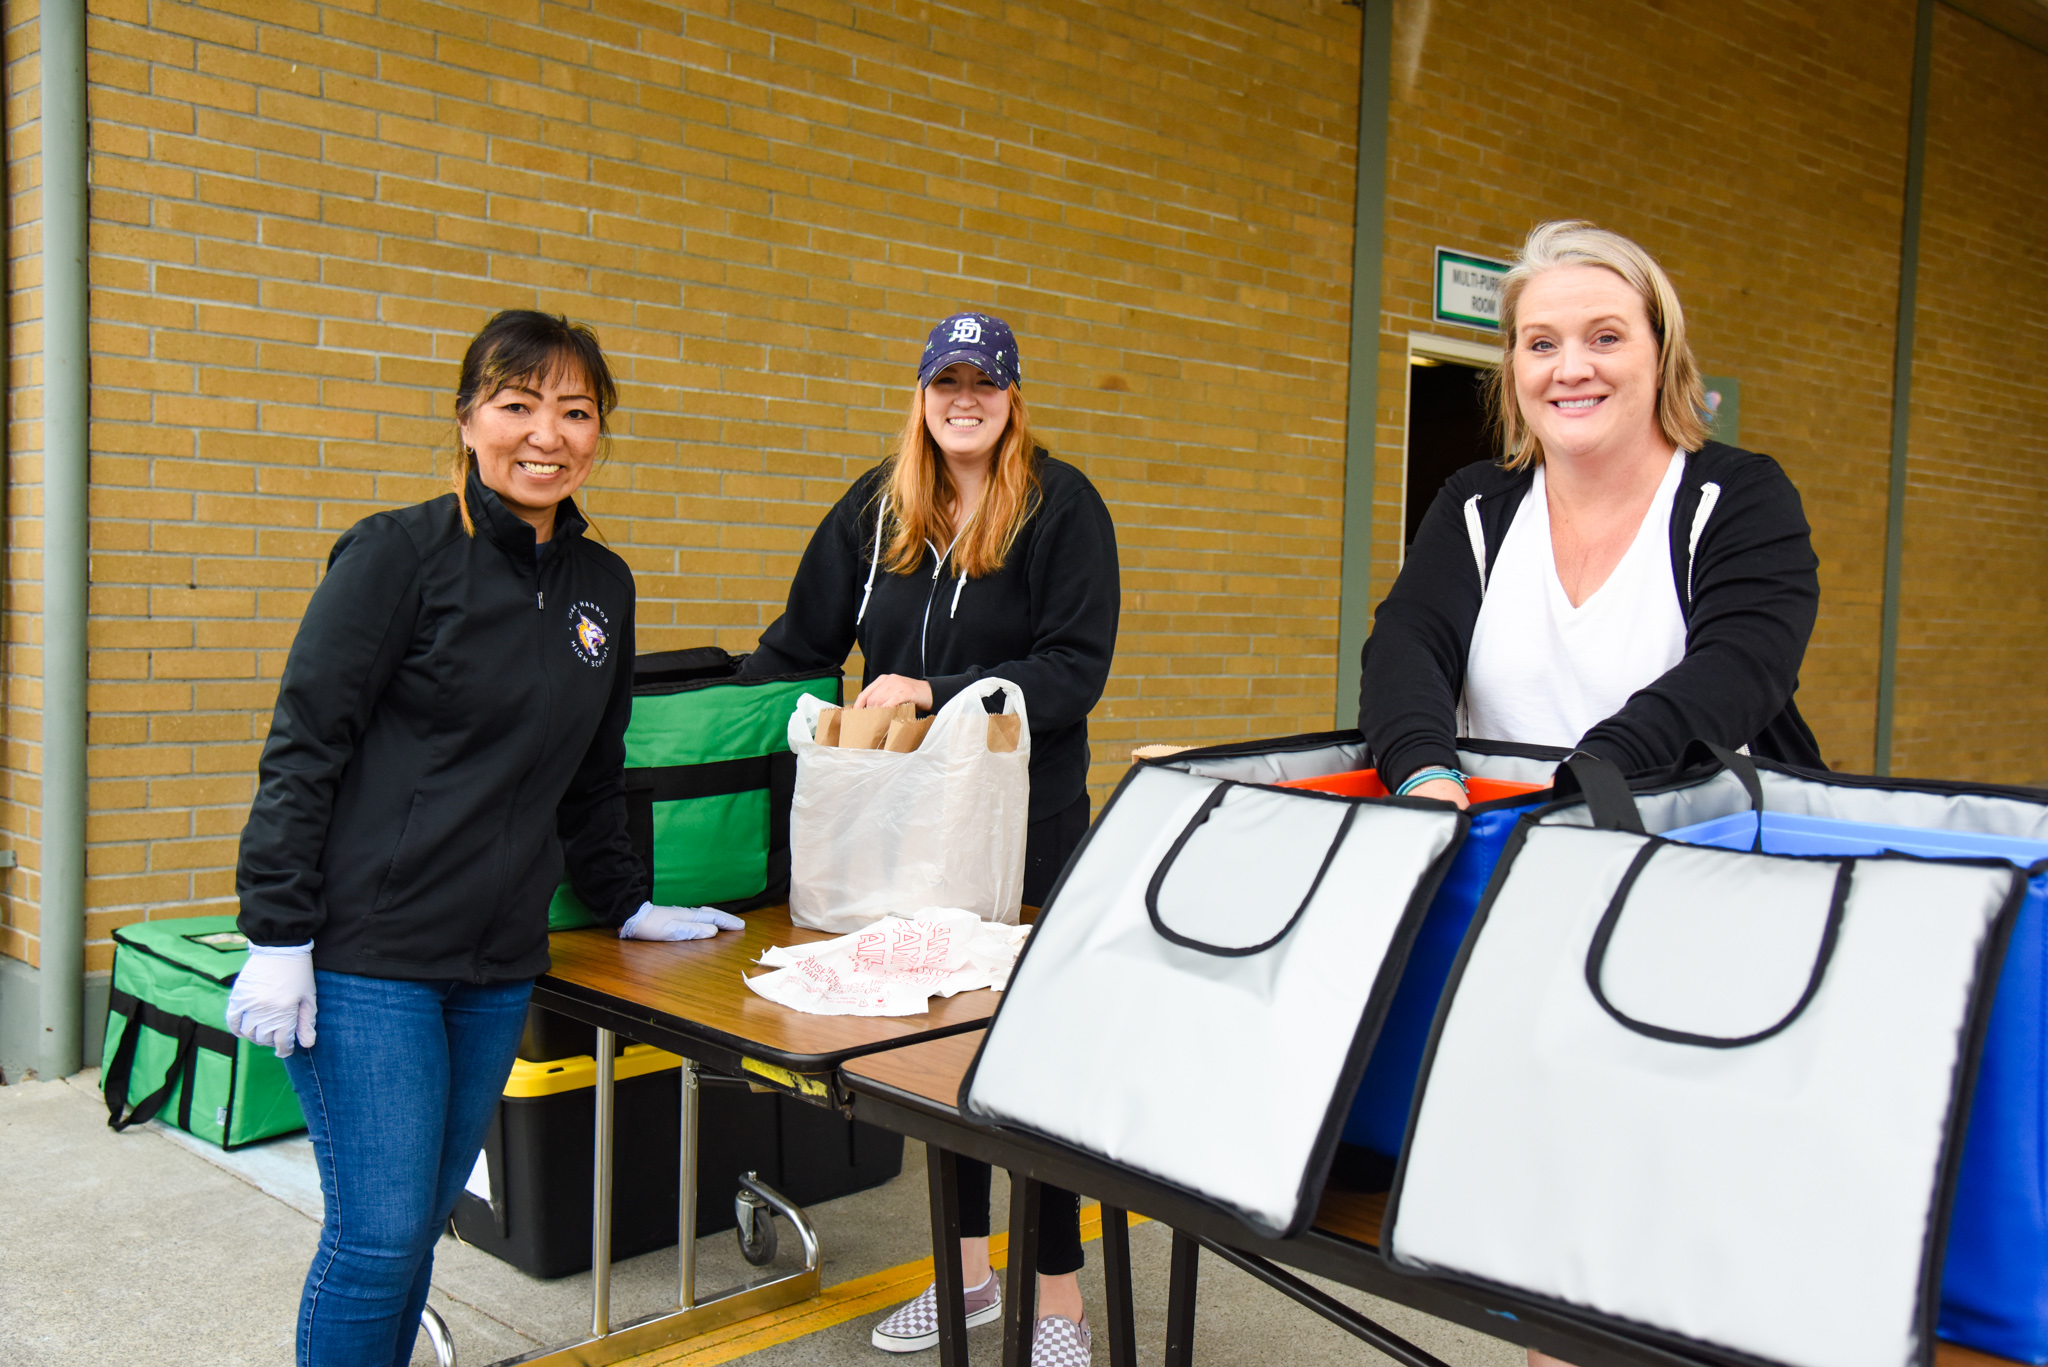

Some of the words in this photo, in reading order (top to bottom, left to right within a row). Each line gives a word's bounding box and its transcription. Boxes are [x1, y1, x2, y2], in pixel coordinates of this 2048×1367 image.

[1472, 296, 1496, 314] ROOM
[949, 317, 982, 344] SD
[568, 604, 578, 619] OAK
[579, 601, 609, 623] HARBOR
[571, 640, 589, 663] HIGH
